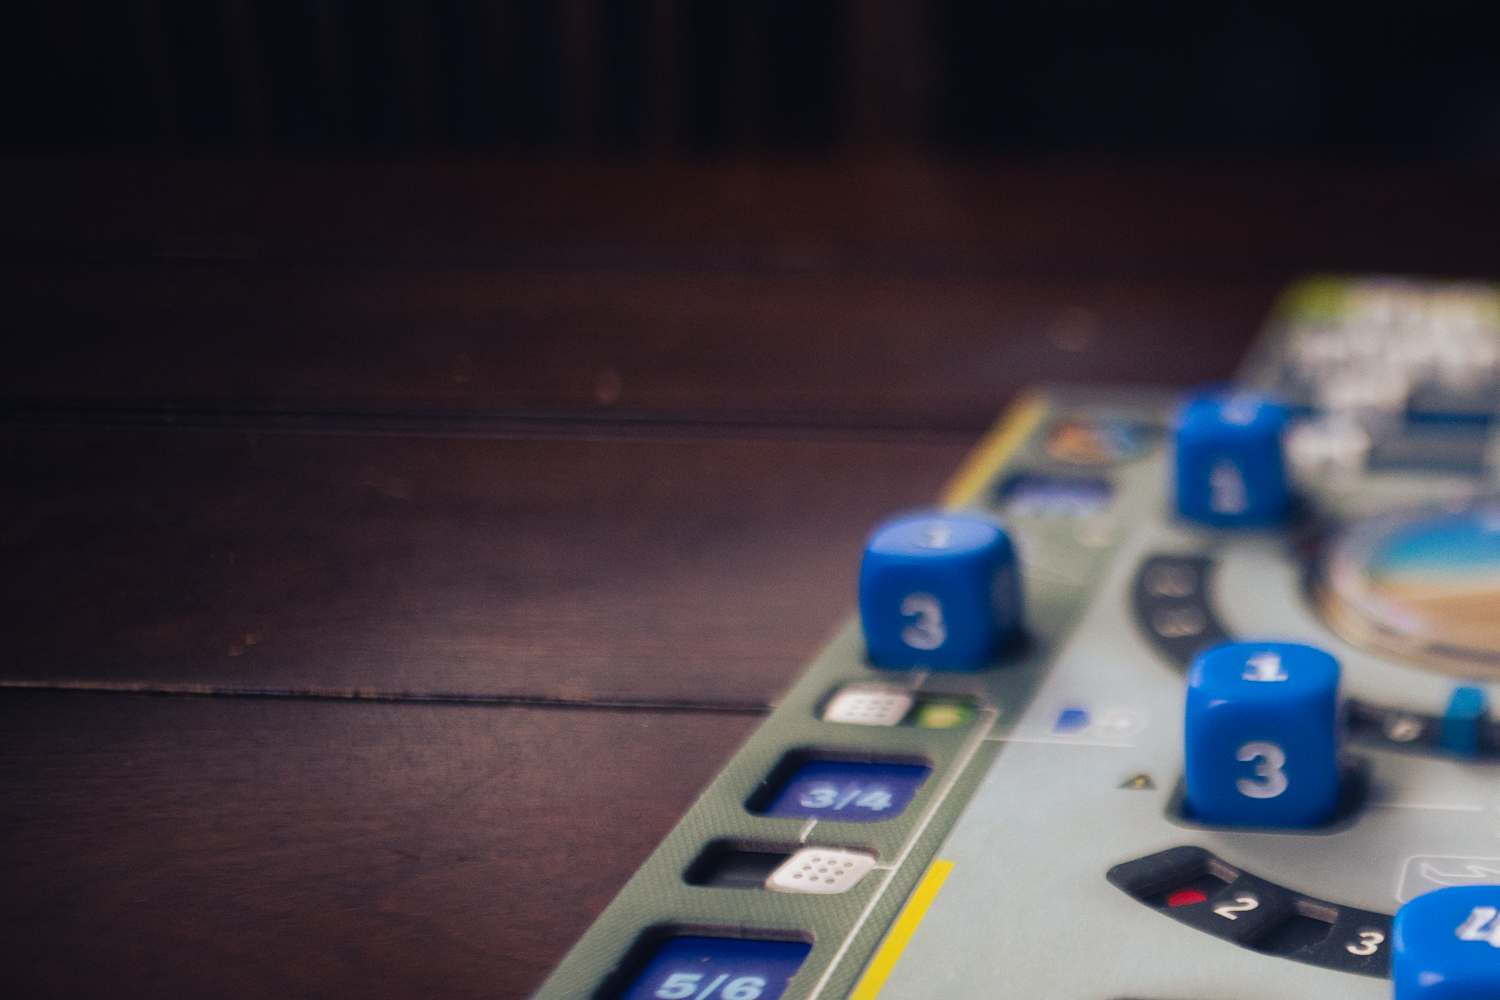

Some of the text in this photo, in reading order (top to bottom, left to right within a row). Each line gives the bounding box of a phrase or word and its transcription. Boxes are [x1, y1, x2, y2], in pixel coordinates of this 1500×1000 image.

[900, 592, 948, 651] 3
[1236, 741, 1288, 799] 3
[799, 789, 894, 812] 3/4
[1213, 897, 1259, 921] 2
[1346, 931, 1384, 956] 3
